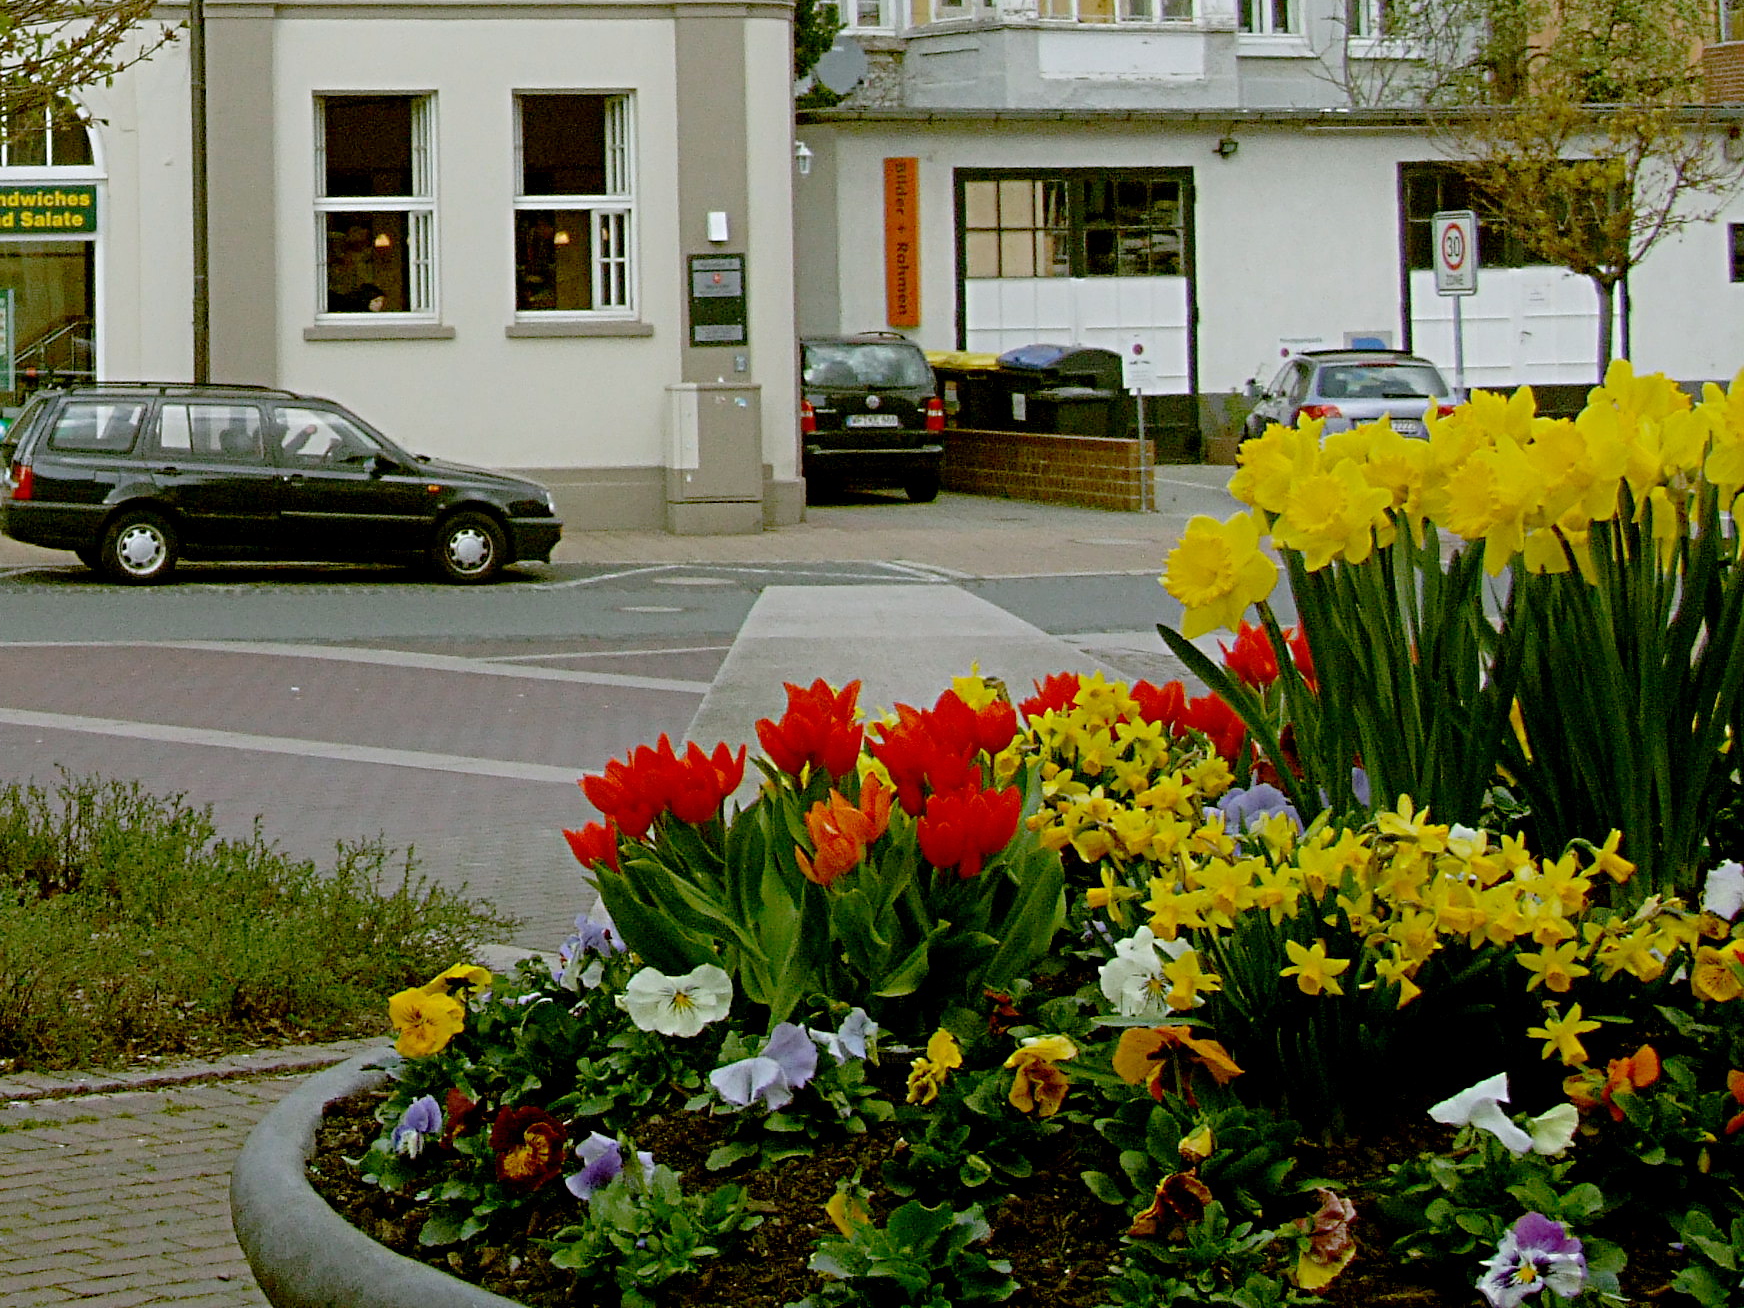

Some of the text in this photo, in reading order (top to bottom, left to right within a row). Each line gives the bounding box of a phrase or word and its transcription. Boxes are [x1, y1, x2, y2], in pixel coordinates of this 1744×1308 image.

[895, 163, 908, 215] Bilder
[20, 211, 84, 228] Salate
[1446, 236, 1461, 257] 30
[896, 242, 910, 315] Rahmen
[1445, 274, 1464, 286] ZONE
